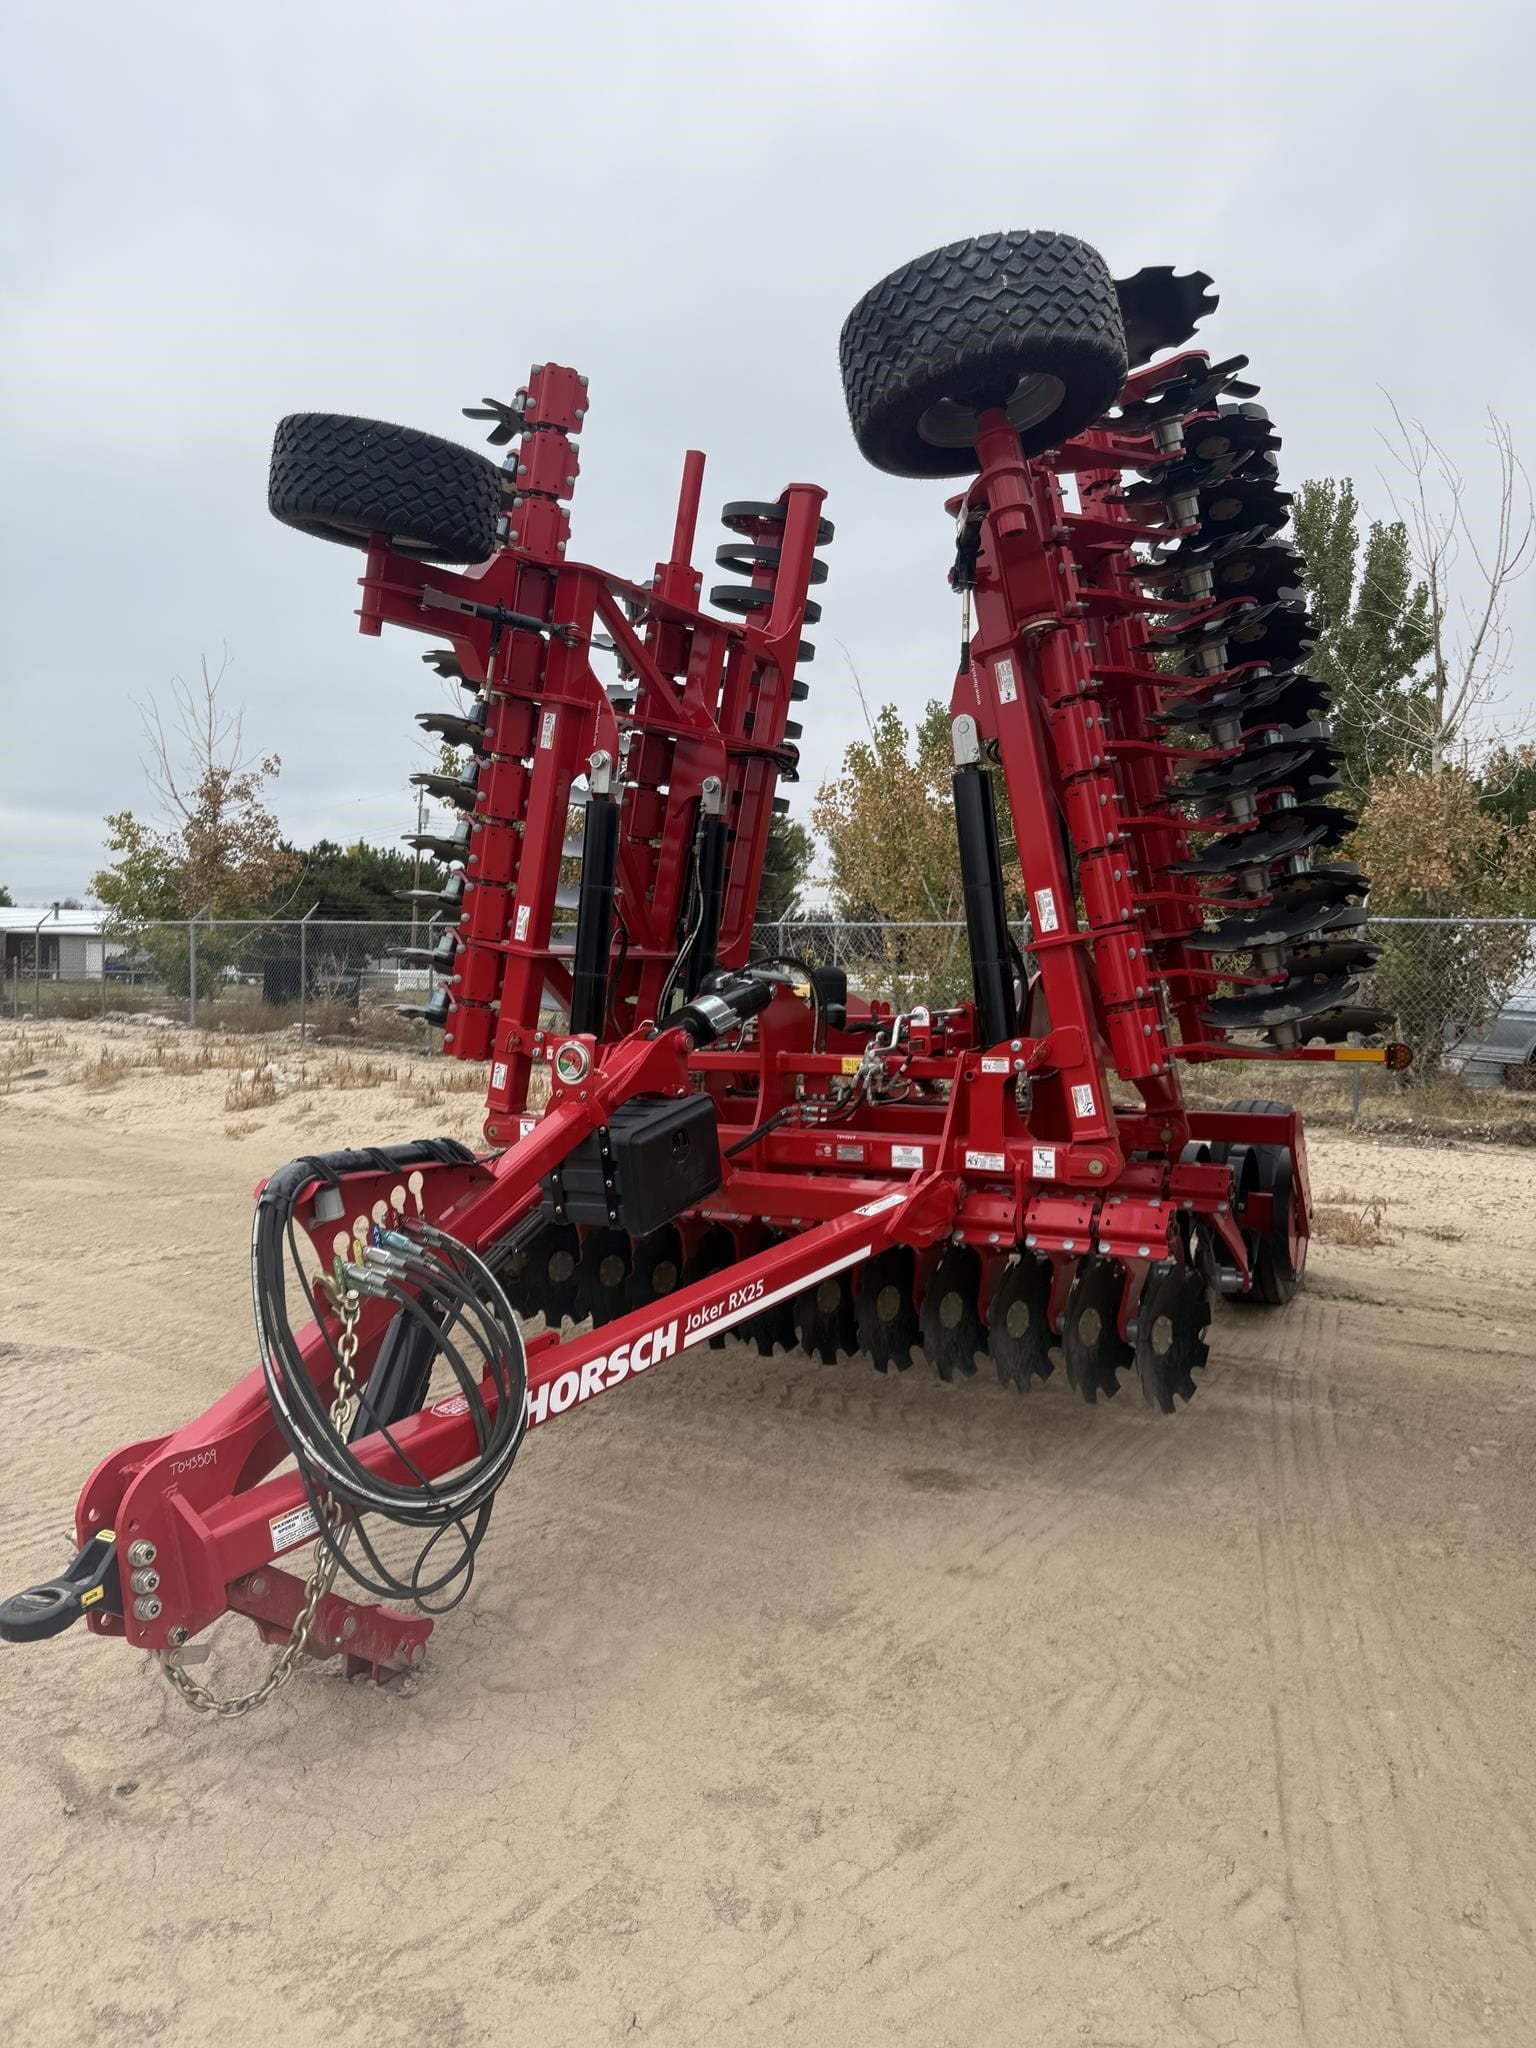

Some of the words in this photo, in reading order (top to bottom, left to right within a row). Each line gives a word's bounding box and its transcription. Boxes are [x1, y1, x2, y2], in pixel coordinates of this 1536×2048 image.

[526, 1319, 679, 1429] HORSCH
[684, 1301, 726, 1334] Joker
[728, 1278, 765, 1312] RX25
[169, 1448, 217, 1476] T043509
[272, 1515, 299, 1530] MAXIMUM
[278, 1523, 296, 1534] SPEED
